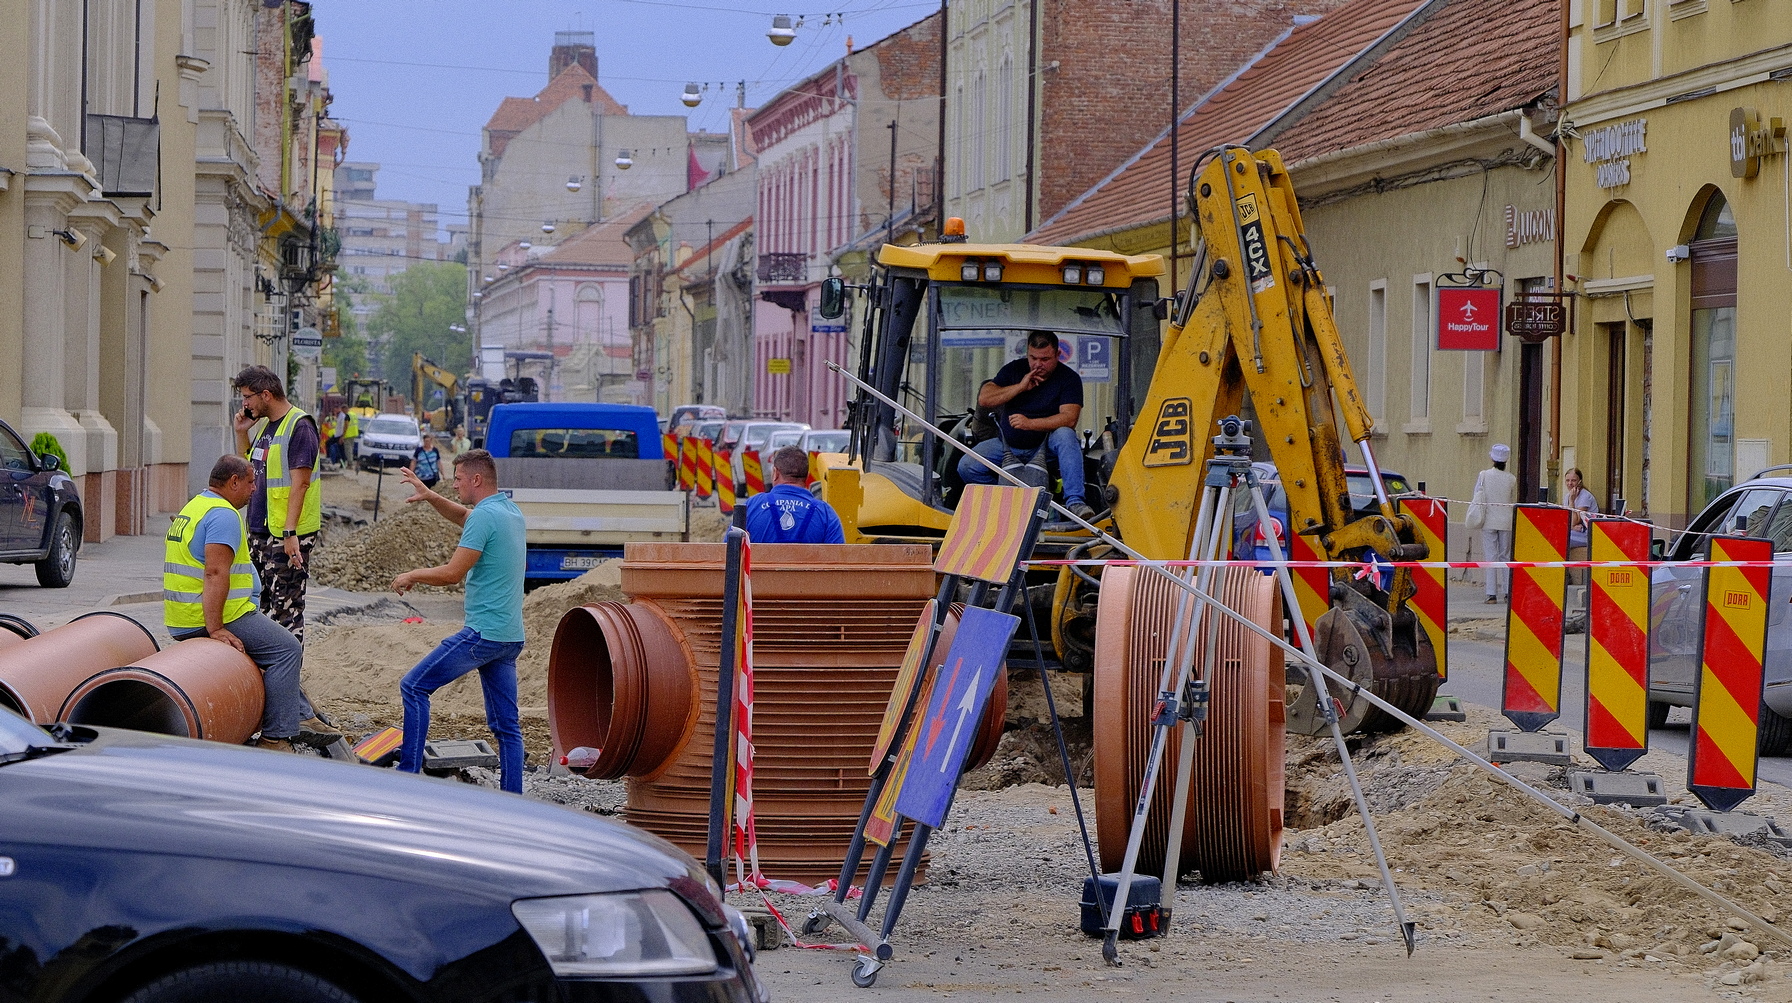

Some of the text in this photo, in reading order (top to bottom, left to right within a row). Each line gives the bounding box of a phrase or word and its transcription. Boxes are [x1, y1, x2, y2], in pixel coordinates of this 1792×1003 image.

[1731, 124, 1746, 161] tbi
[1239, 203, 1256, 219] JCB
[1245, 226, 1269, 276] 4CX
[1448, 322, 1489, 333] HappyTour
[1087, 342, 1101, 360] P
[1150, 402, 1188, 459] JCB
[564, 558, 578, 567] BH
